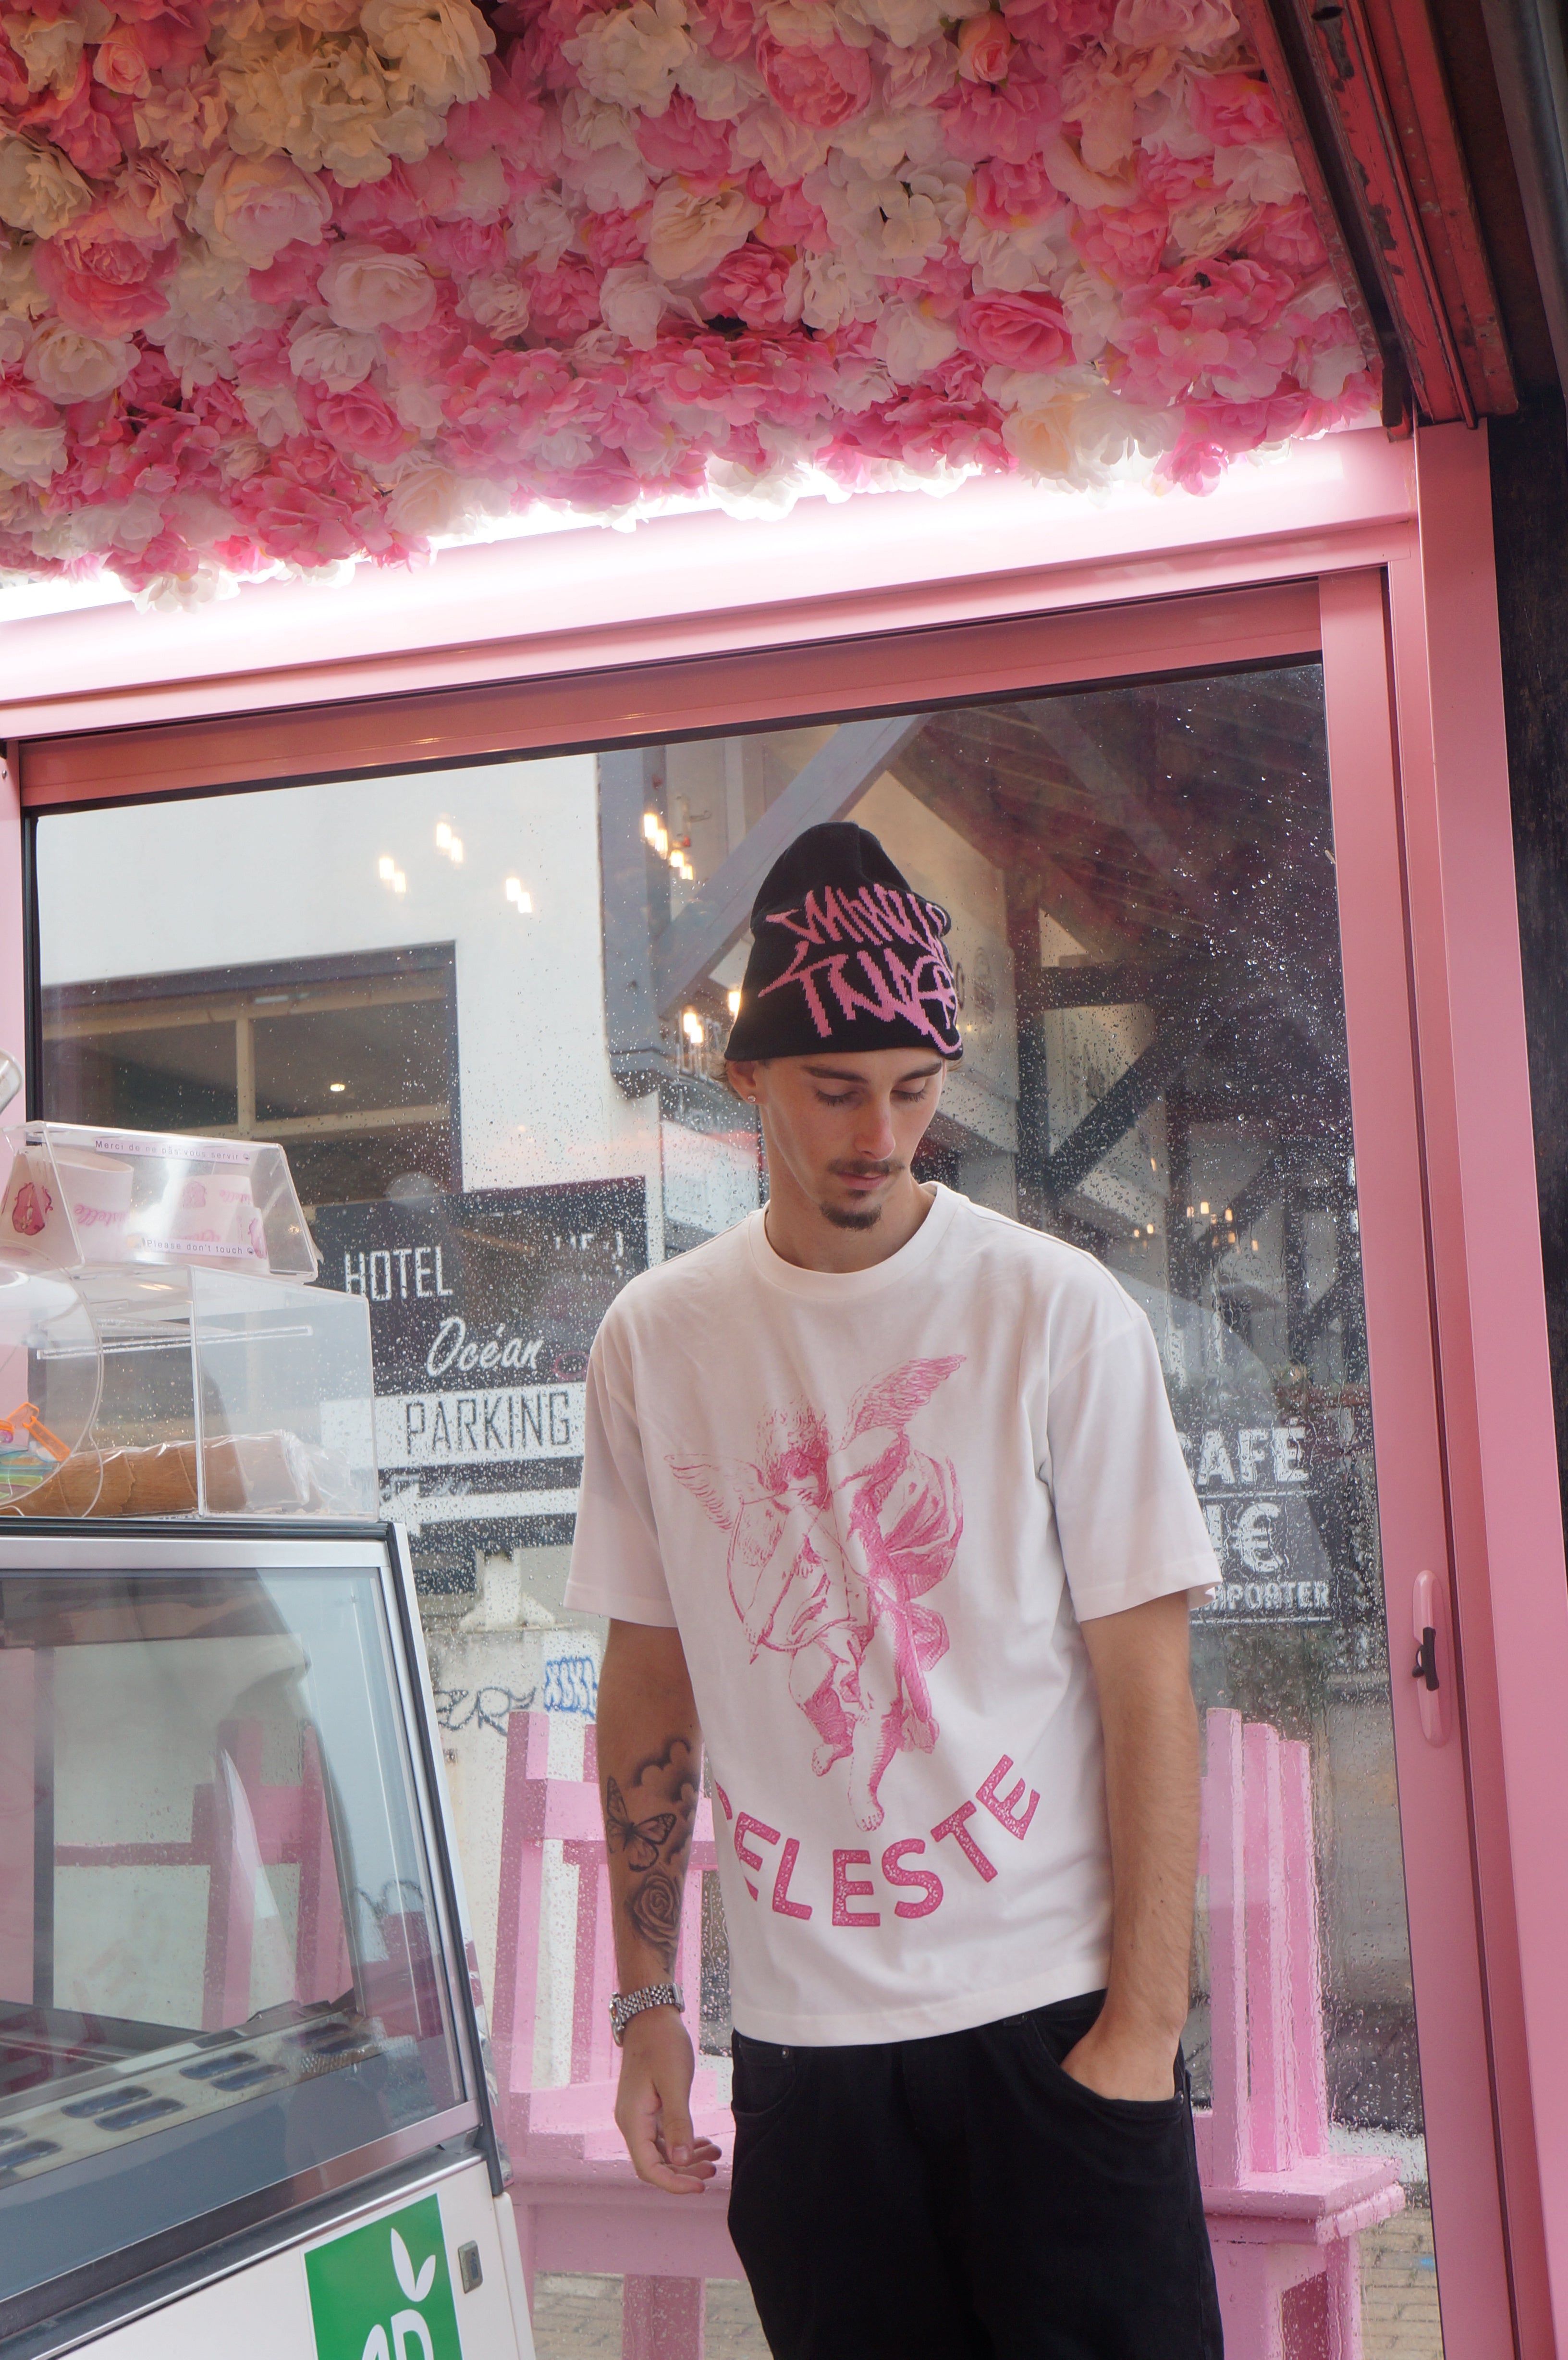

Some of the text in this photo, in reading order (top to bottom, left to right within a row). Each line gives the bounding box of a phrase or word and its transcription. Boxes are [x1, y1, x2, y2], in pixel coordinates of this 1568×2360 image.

[96, 1140, 123, 1150] Merci
[147, 1240, 242, 1254] Please don't touch
[344, 1245, 453, 1302] HOTEL
[427, 1316, 543, 1377] Océan
[406, 1390, 573, 1454] PARKING
[714, 1754, 1041, 1927] ELESTE
